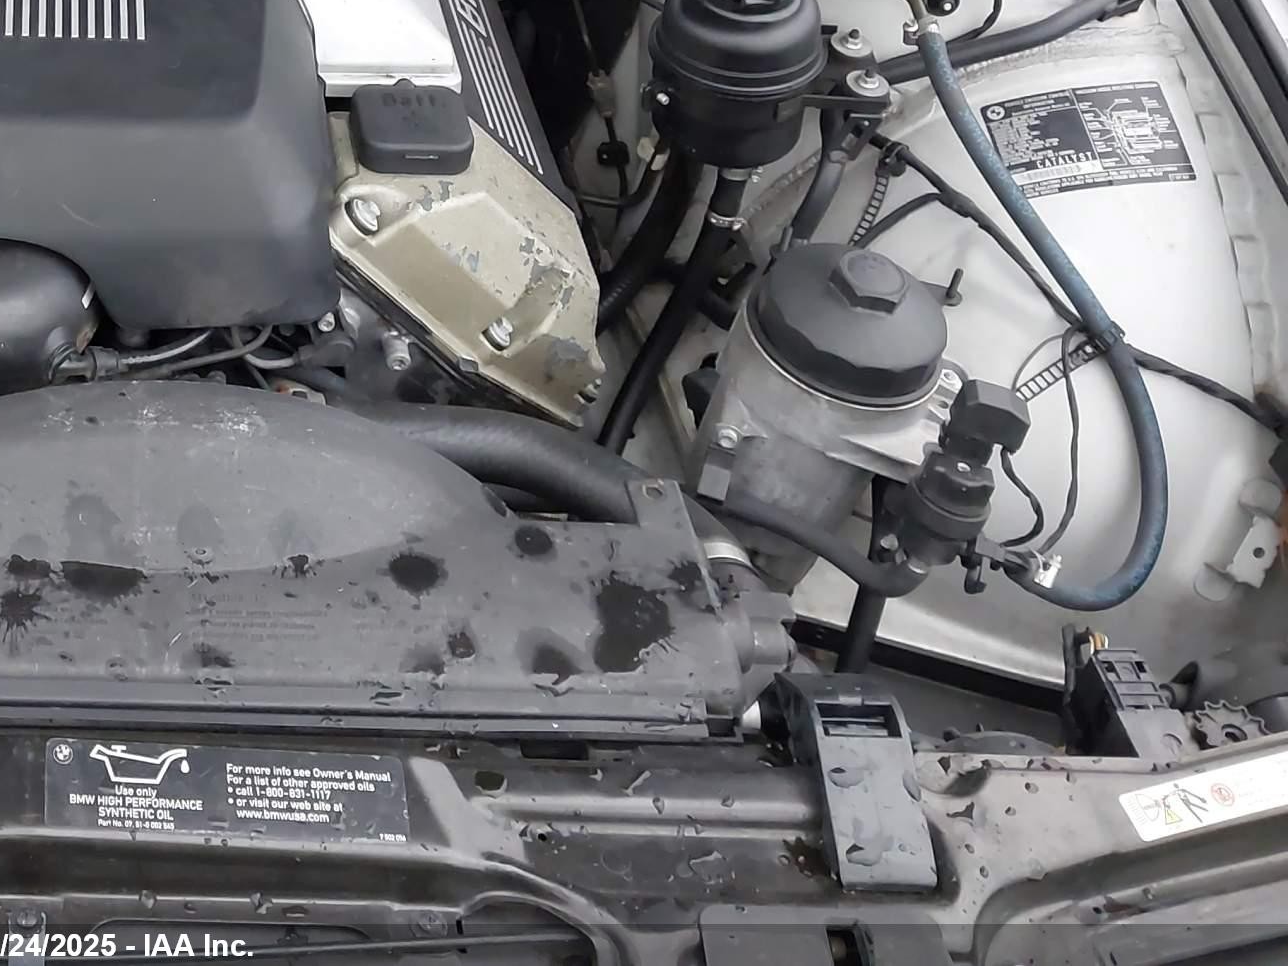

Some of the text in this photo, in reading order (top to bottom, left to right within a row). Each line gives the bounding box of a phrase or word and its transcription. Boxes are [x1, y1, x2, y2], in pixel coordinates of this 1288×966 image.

[1036, 151, 1094, 170] CATALYST
[226, 763, 392, 782] For more info see Owner's Manual
[226, 774, 376, 792] For a list of other approved oils
[115, 785, 158, 799] Use only
[235, 786, 332, 800] call 1-800-831-1117
[69, 794, 203, 811] BMW HIGH PERFORMANCE
[236, 797, 344, 812] or visit our web site at
[98, 807, 174, 822] SYNTHETIC OIL
[236, 808, 330, 823] www.bmwusa.com
[97, 819, 111, 827] Part
[112, 819, 123, 827] No.
